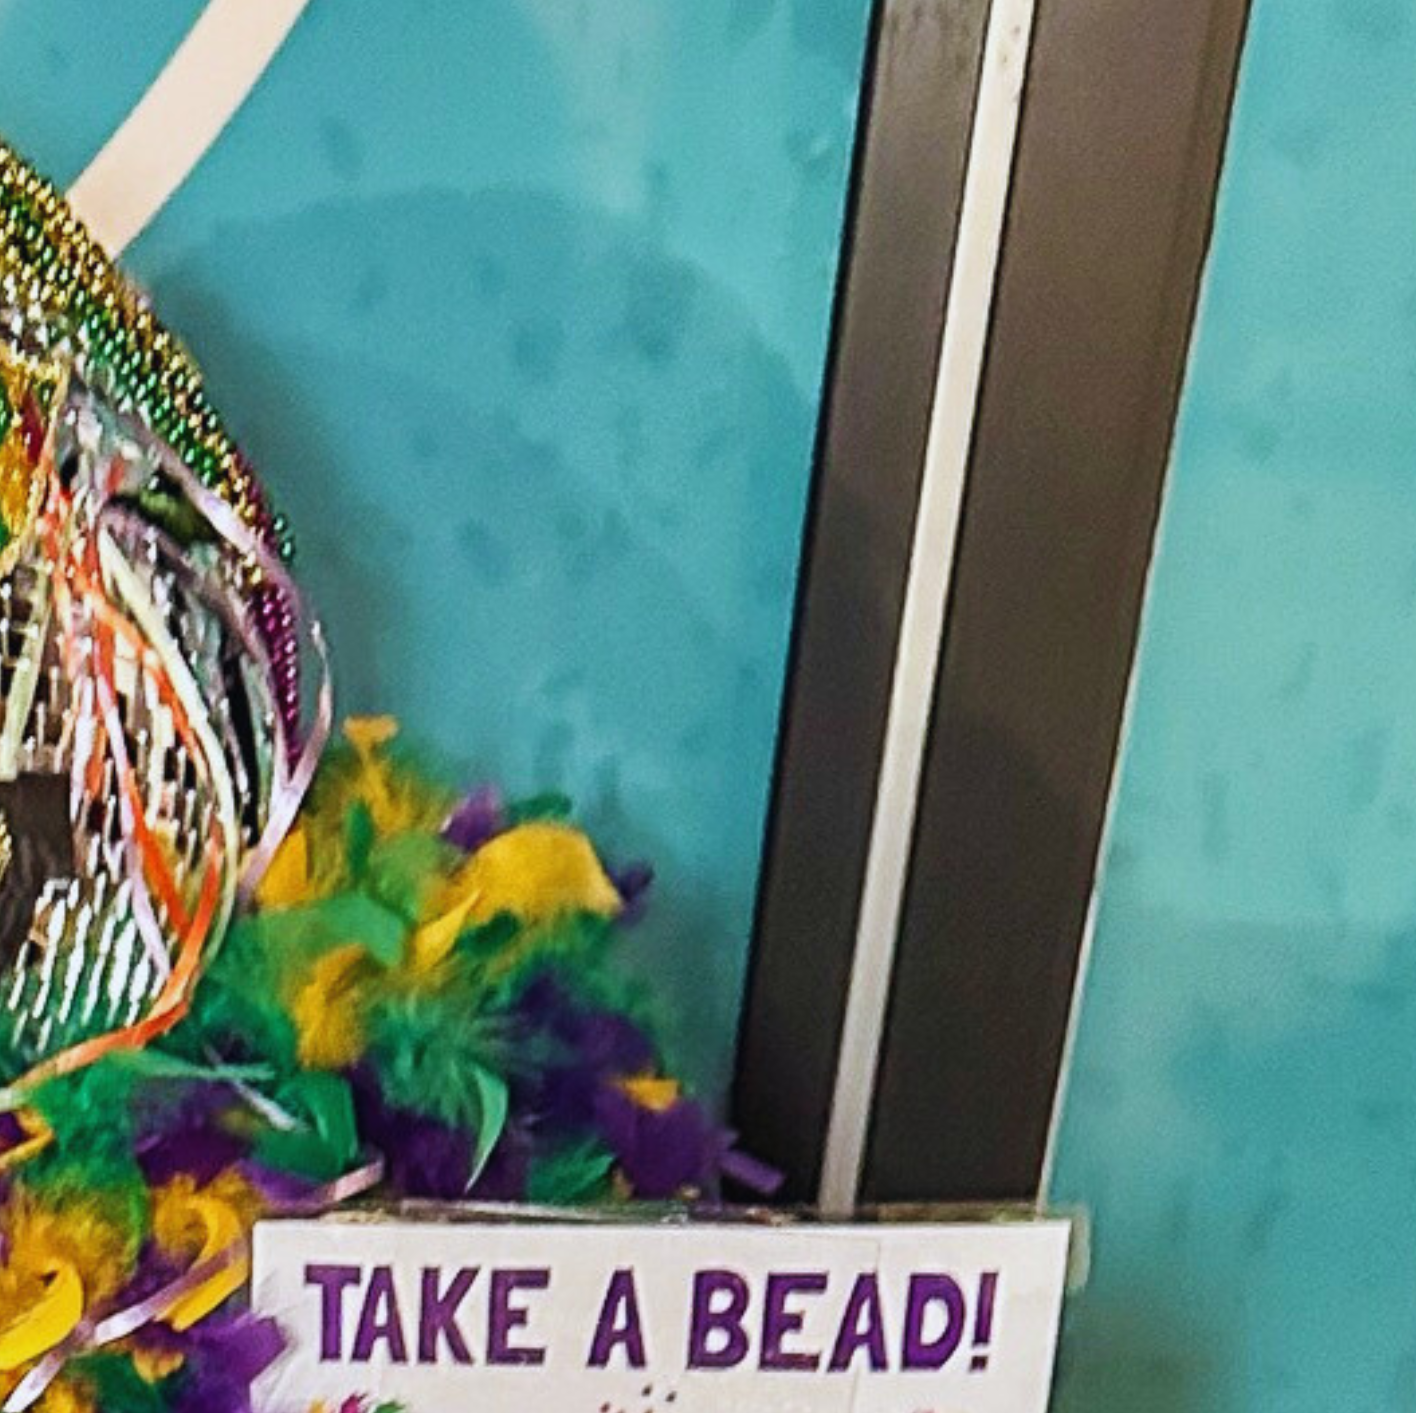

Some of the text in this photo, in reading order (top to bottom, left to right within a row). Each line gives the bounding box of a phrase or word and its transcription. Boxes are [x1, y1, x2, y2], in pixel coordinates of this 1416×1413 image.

[304, 1264, 1000, 1373] TAKE A BEAD!
